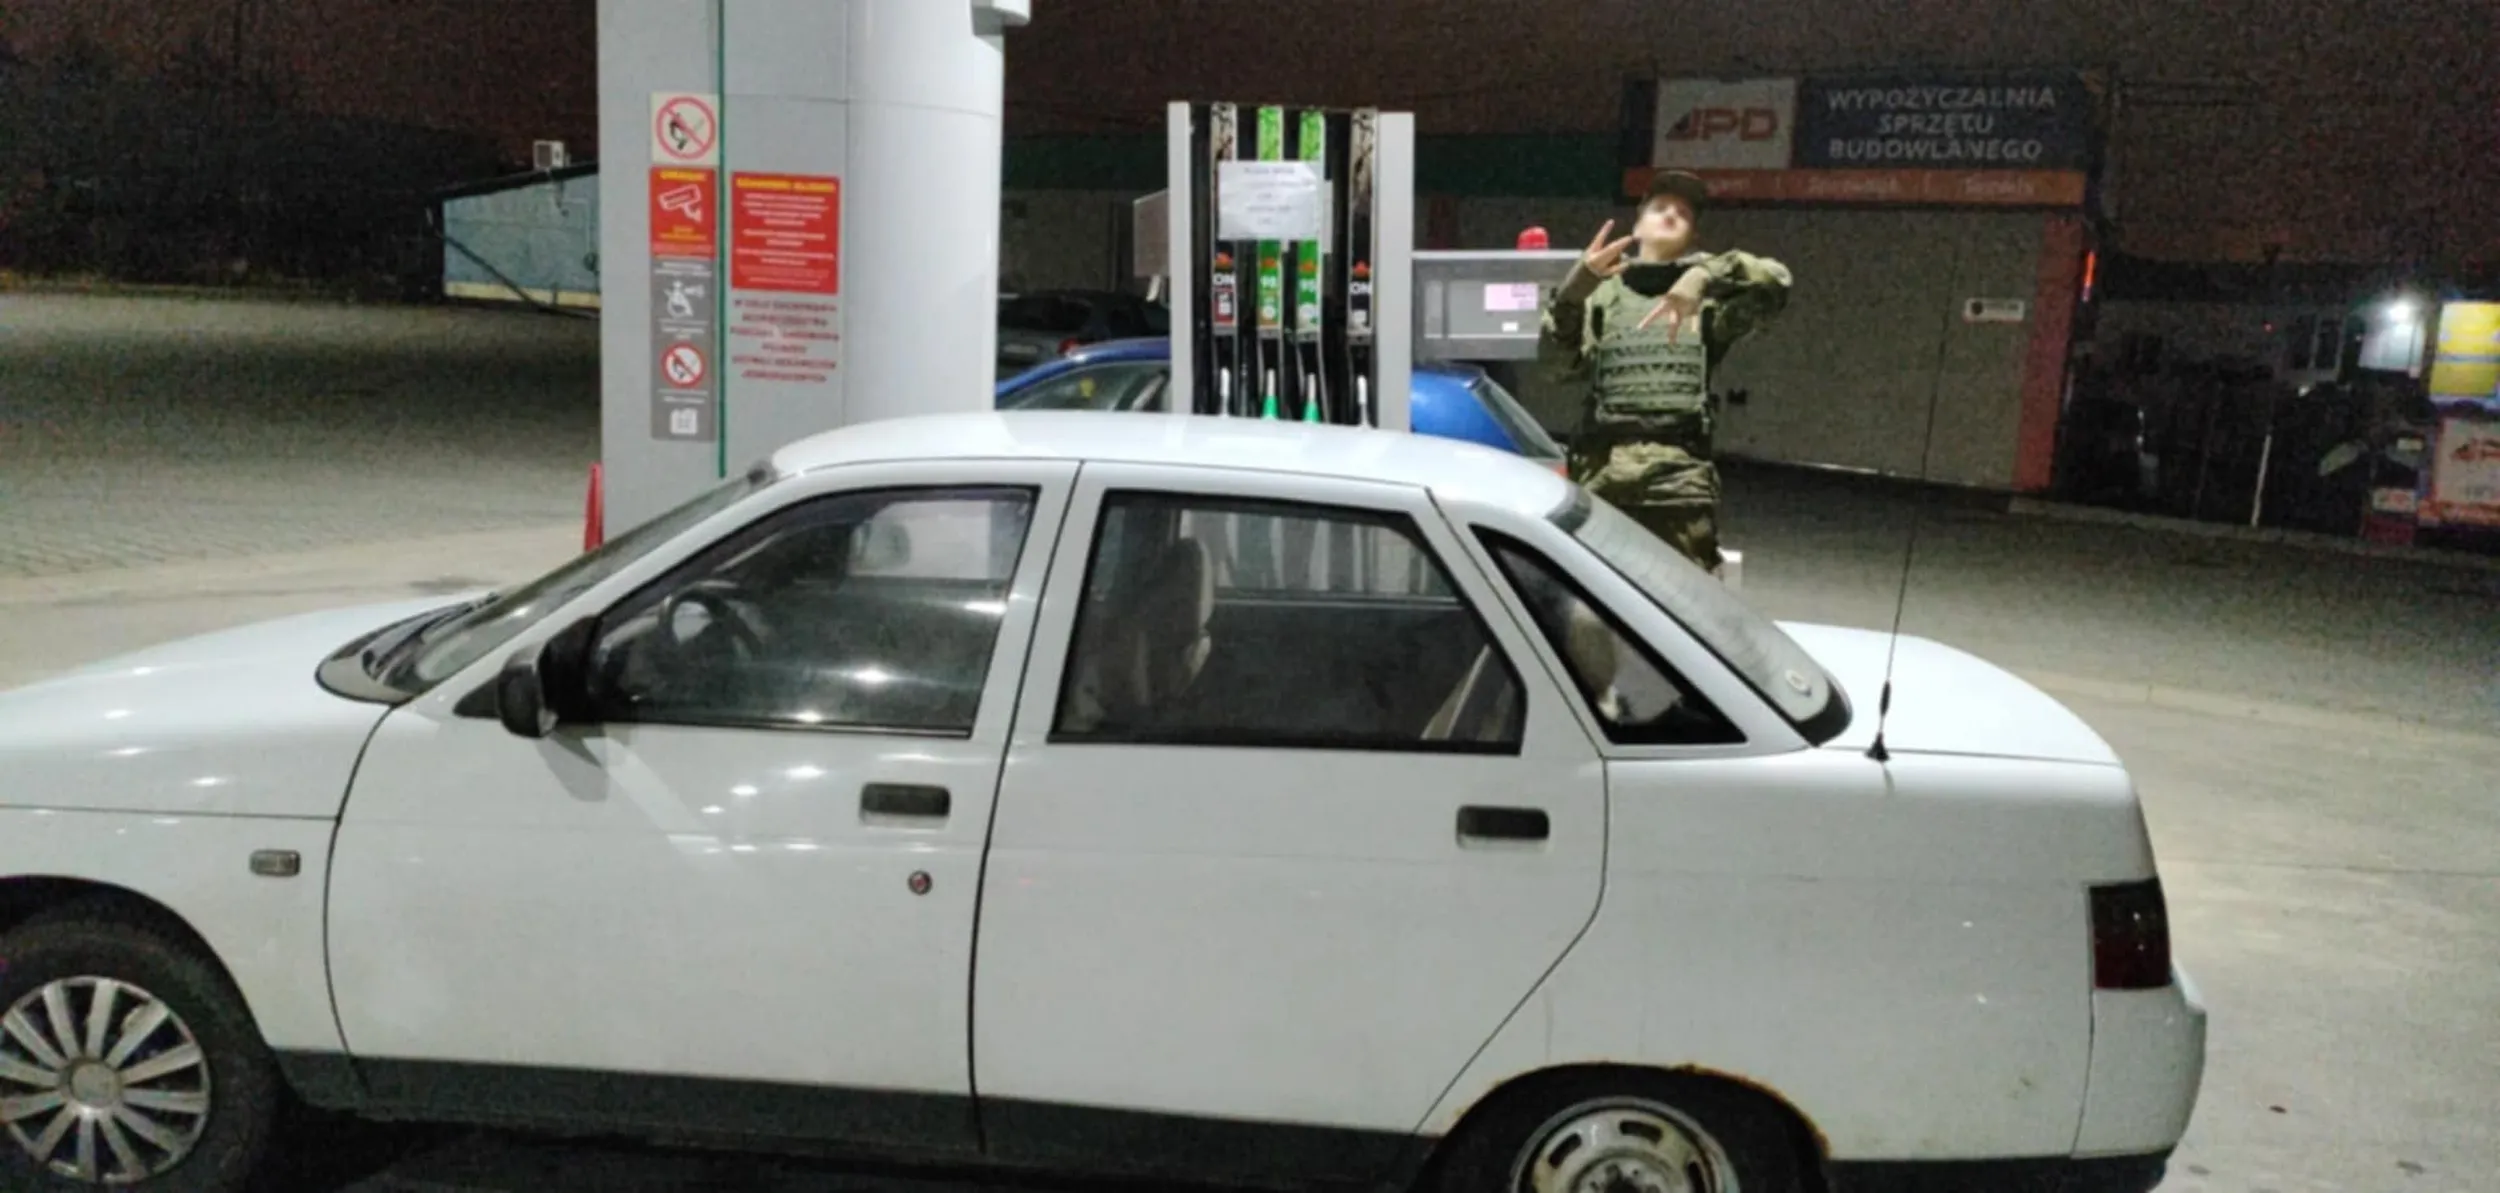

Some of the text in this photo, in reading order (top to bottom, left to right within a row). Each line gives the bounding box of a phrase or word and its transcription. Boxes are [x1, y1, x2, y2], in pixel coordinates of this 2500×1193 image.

[1827, 86, 2056, 110] WYPOŻYCZALNIA
[1664, 108, 1778, 142] JPD
[1878, 112, 1994, 139] SPRZĘTU
[1829, 139, 2044, 161] BUDOWLANEGO
